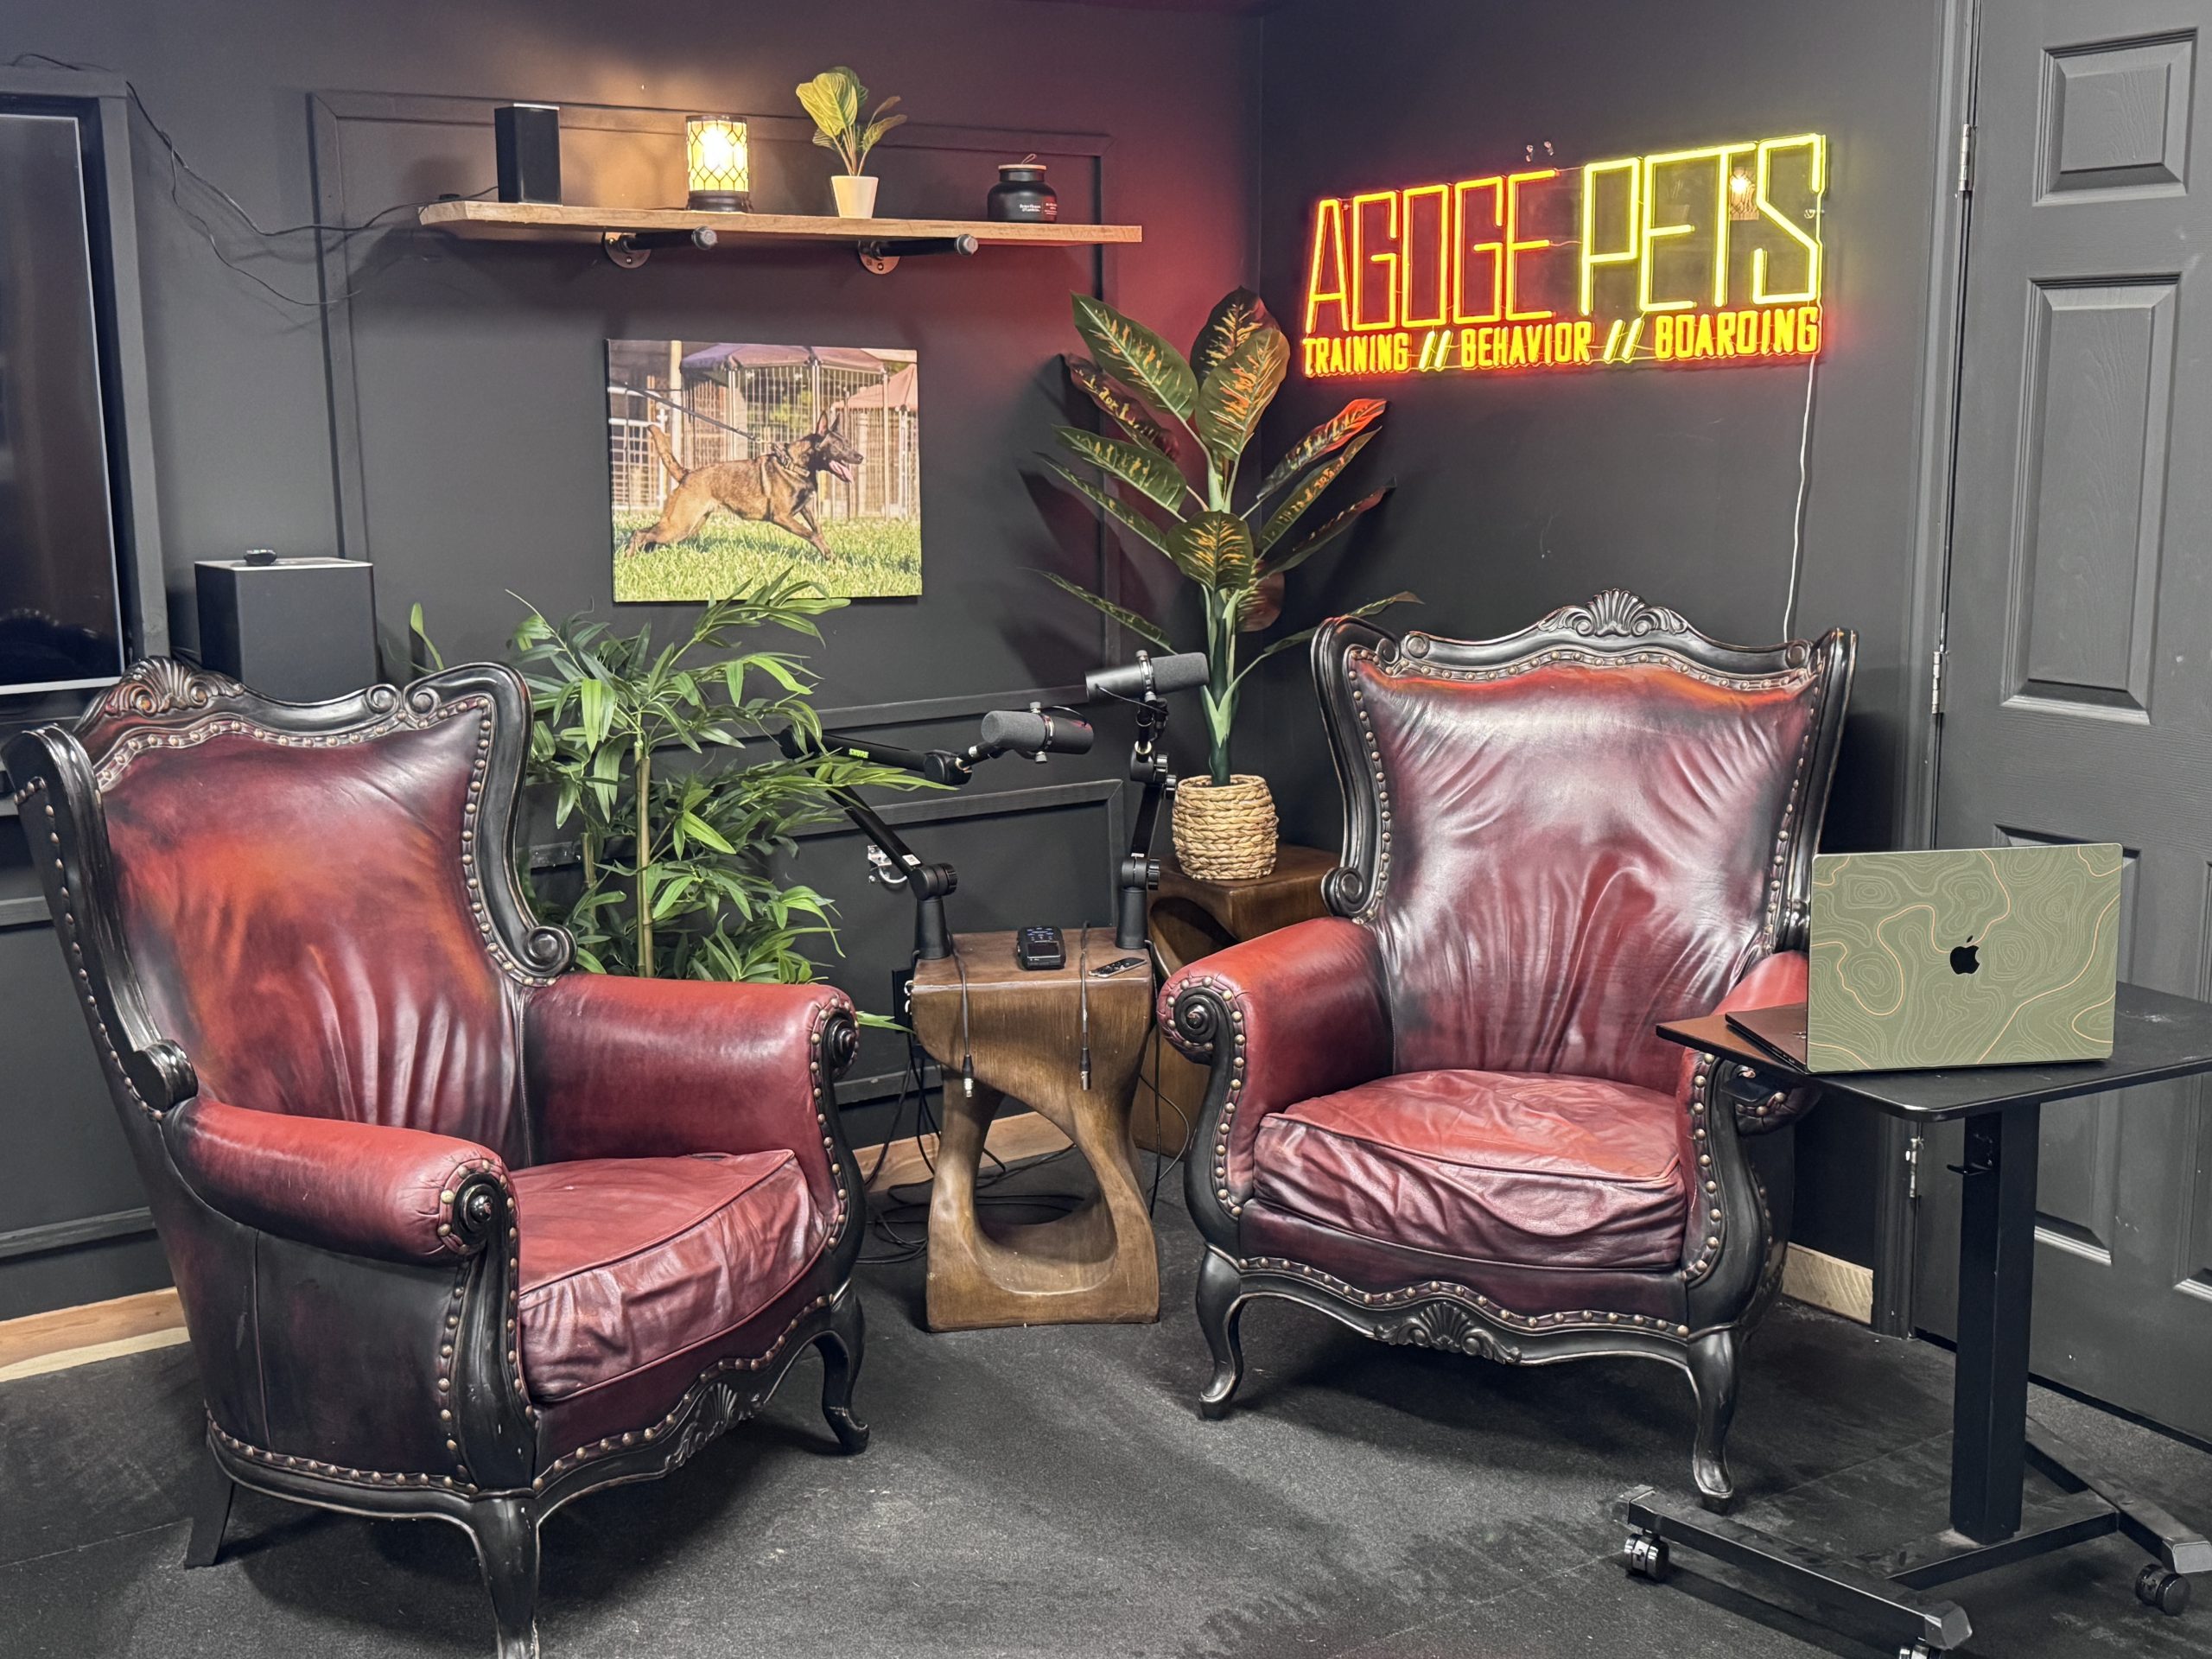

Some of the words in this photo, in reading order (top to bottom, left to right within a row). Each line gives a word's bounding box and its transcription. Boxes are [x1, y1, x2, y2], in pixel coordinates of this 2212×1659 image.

[1305, 168, 1560, 333] AGOGE
[1581, 132, 1827, 316] PETS
[1302, 332, 1410, 376] TRAINING
[1459, 321, 1592, 369] BEHAVIOR
[1654, 306, 1820, 360] BOARDING
